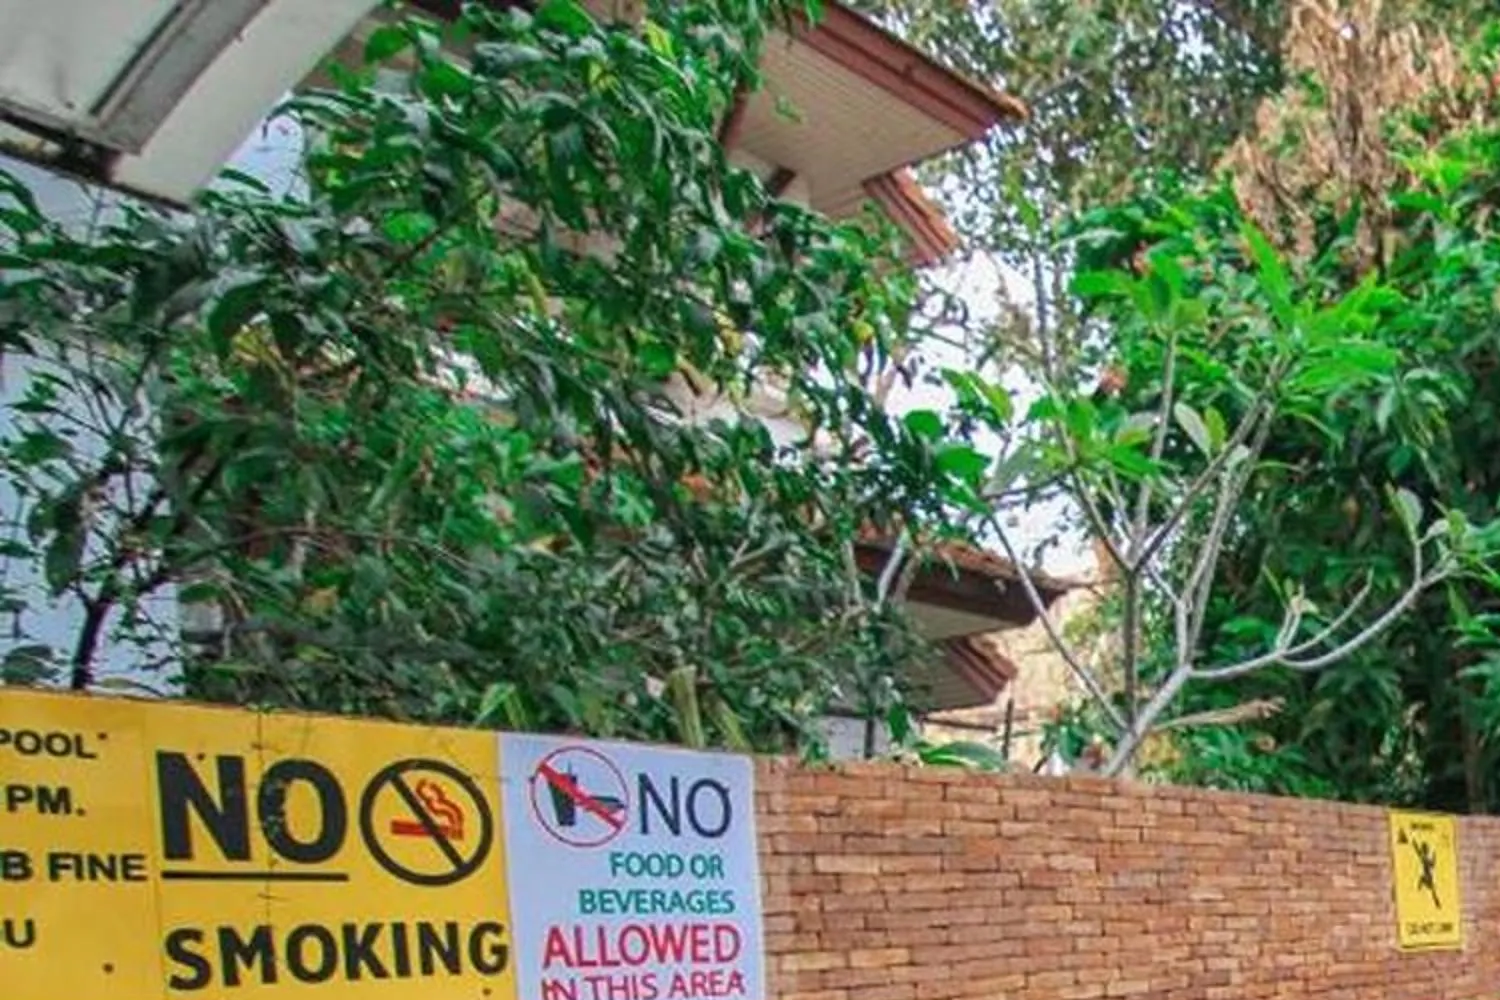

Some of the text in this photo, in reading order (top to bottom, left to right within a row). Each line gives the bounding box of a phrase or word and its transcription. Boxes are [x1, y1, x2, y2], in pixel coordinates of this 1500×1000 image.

[6, 784, 86, 816] PM.
[155, 750, 348, 864] NO
[637, 772, 732, 838] NO
[47, 852, 148, 882] FINE
[610, 852, 725, 879] FOOD OR
[579, 889, 736, 914] BEVERAGES
[165, 922, 508, 990] SMOKING
[542, 923, 742, 970] ALLOWED
[669, 970, 746, 998] AREA
